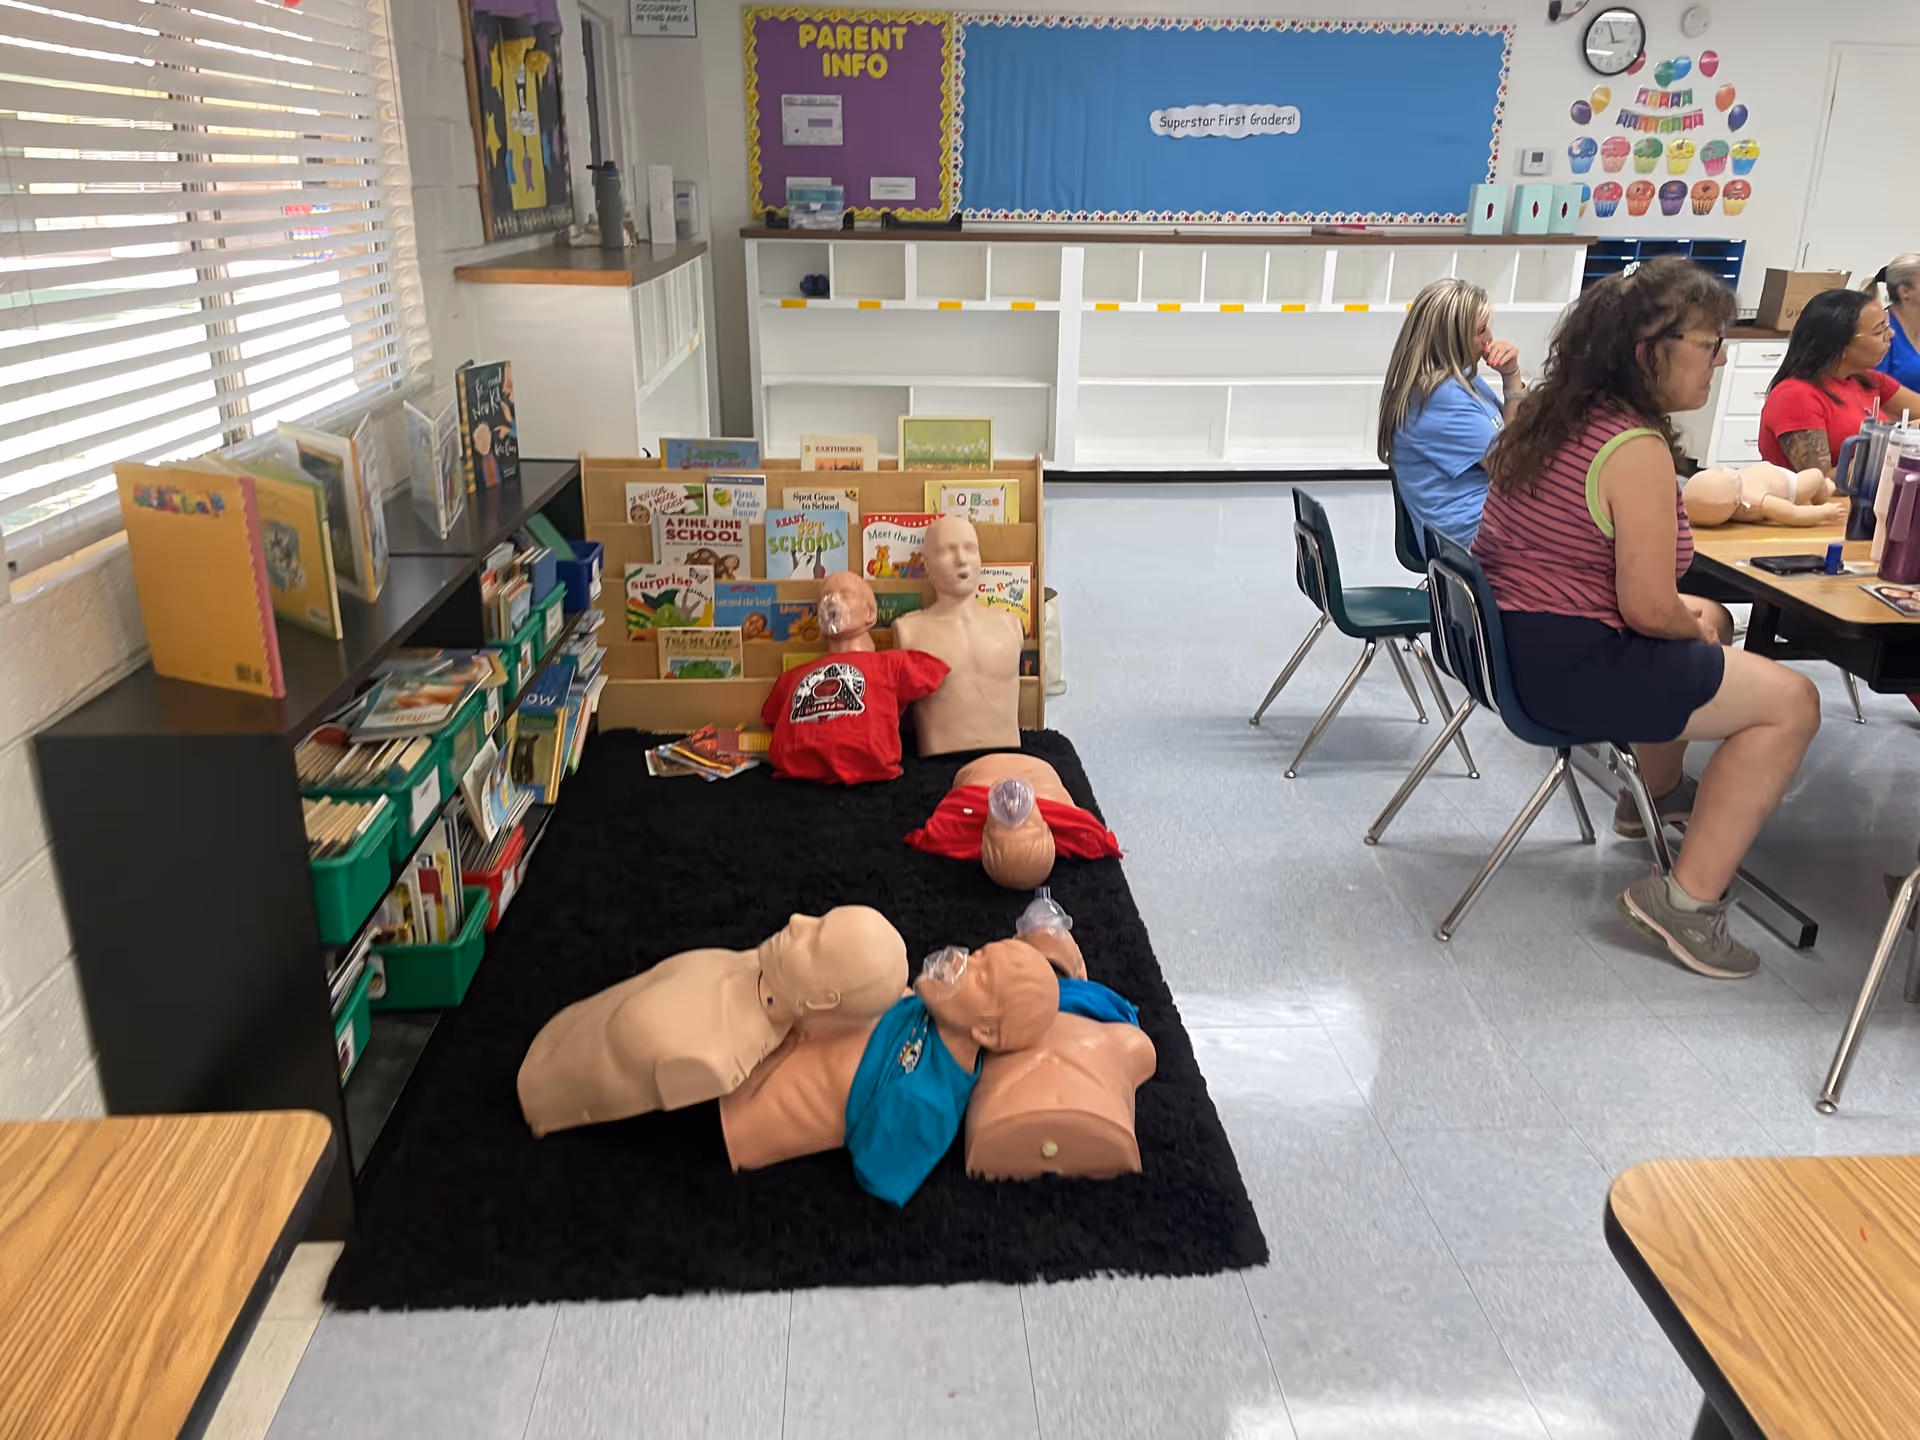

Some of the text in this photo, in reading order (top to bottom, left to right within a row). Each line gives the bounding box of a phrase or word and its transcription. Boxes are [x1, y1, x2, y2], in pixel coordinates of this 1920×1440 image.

[799, 23, 908, 51] PARENT
[823, 52, 888, 79] INFO
[1159, 112, 1296, 132] Superstar First Graders!
[733, 488, 753, 499] First
[793, 492, 835, 503] Spot Goes
[736, 498, 760, 508] Grade
[802, 502, 840, 510] to School
[664, 518, 675, 528] A
[713, 519, 742, 530] FINE
[665, 529, 743, 543] SCHOOL
[768, 528, 846, 555] SCHOOL!
[868, 528, 925, 545] Meet the Bar
[631, 572, 693, 590] surprise
